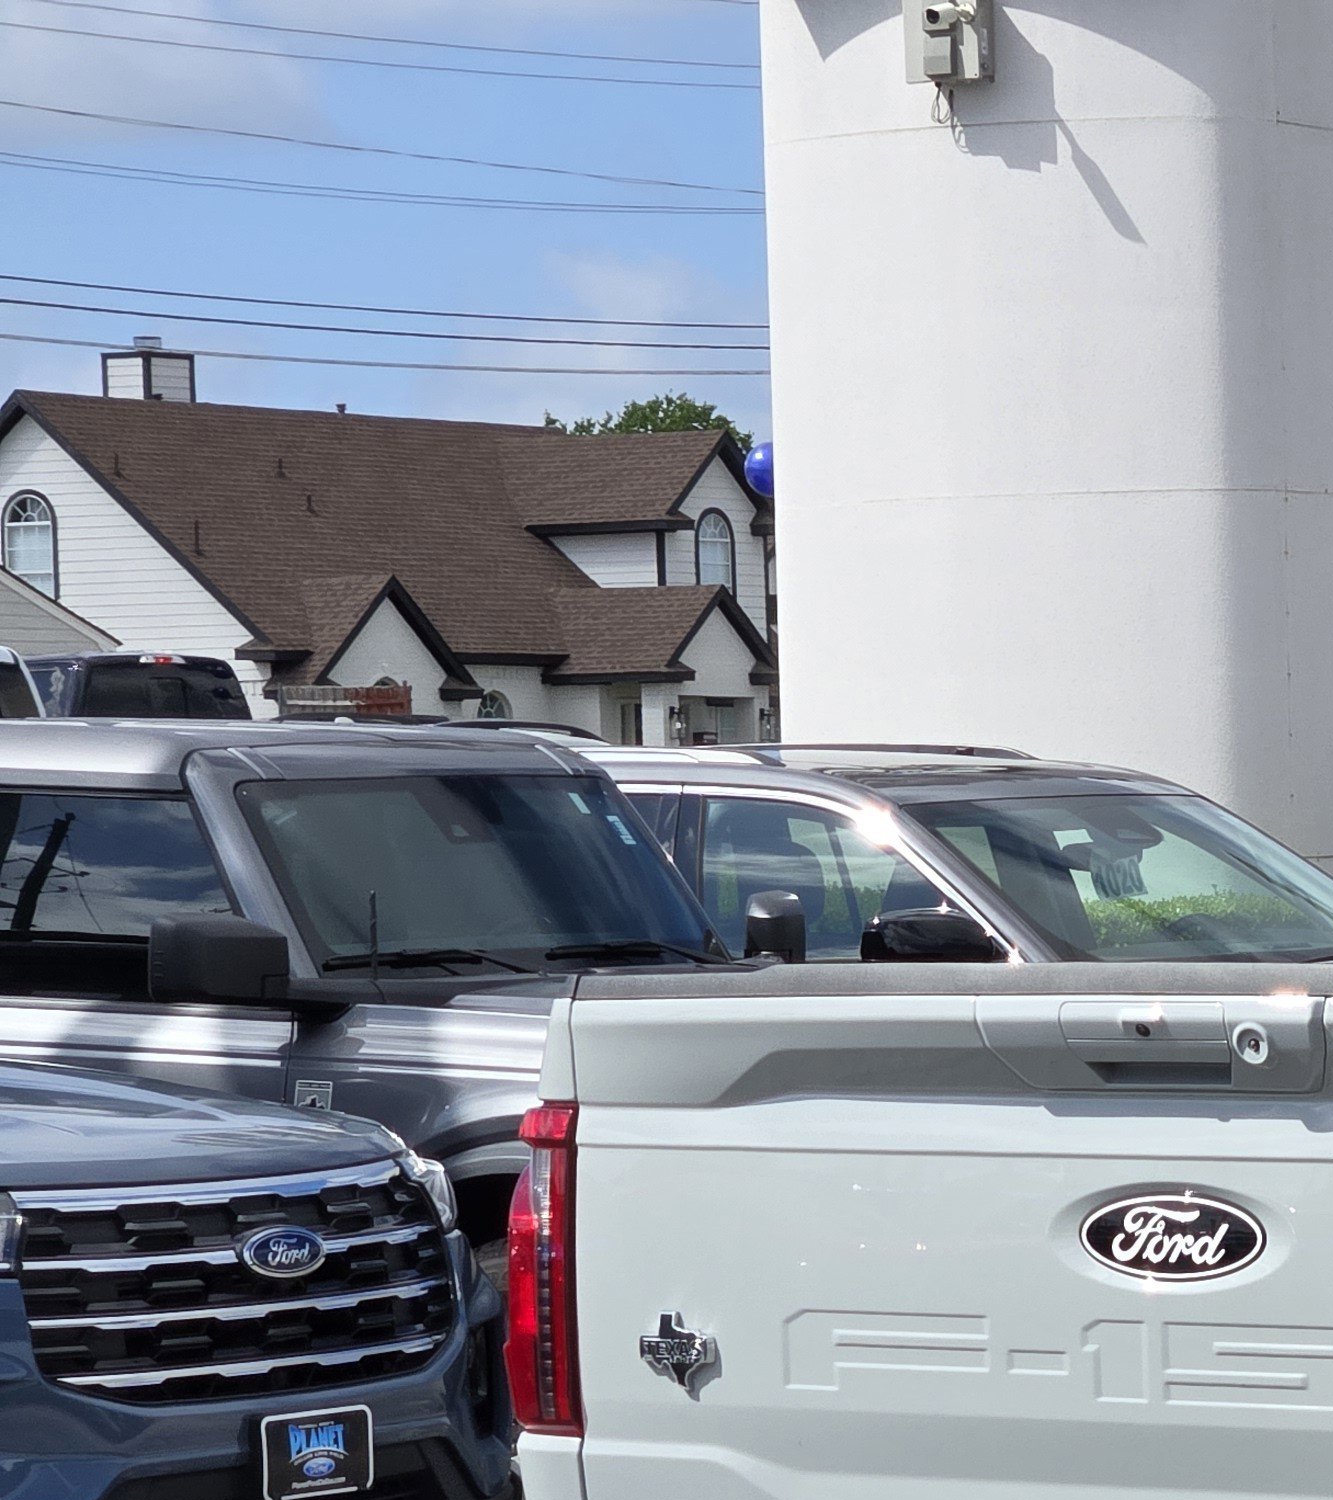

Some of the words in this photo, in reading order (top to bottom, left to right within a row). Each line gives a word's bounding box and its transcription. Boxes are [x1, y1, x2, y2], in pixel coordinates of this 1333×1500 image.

[267, 1237, 311, 1266] Ford
[1111, 1205, 1230, 1266] Ford
[643, 1339, 703, 1358] TEXAS
[288, 1422, 345, 1462] PLANET
